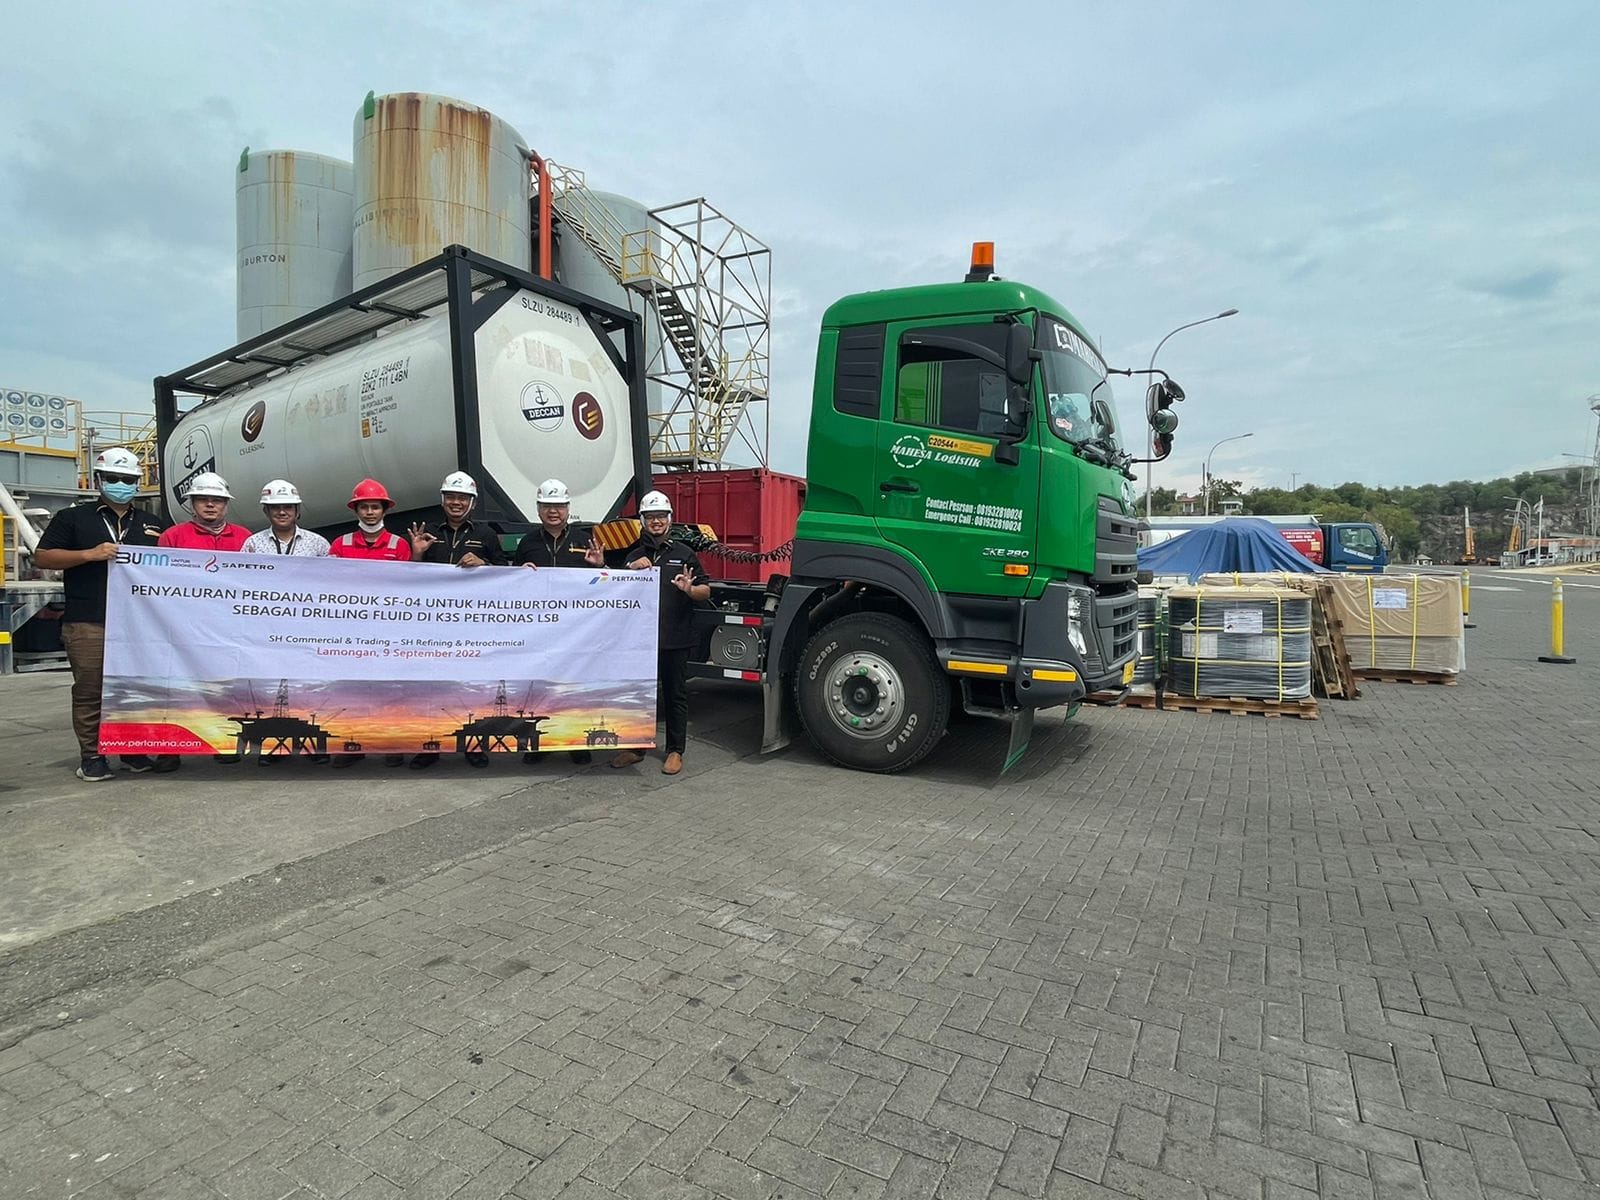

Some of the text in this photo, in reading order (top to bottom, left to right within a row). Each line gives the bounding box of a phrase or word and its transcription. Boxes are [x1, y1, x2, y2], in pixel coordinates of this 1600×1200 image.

[521, 297, 544, 314] SLZU
[546, 305, 573, 325] 284489
[363, 368, 380, 382] SLZU
[528, 406, 561, 418] DECCAN
[928, 437, 954, 448] C20544
[890, 444, 982, 468] MAHESA Logistik
[926, 497, 949, 510] Contact
[925, 509, 958, 523] Emergency
[959, 513, 972, 525] Call
[222, 562, 275, 570] SAPETRO
[131, 585, 641, 610] PENYALURAN PERDANA PRODUK SF-04 UNTUK HALLIBURTON INDONESIA
[232, 604, 560, 623] SEBAGAI DRILLING FLUID DI K3S PETRONAS LSB
[268, 634, 282, 642] SH
[286, 635, 342, 644] Commercial
[345, 637, 353, 645] &
[356, 637, 390, 647] Trading
[401, 638, 413, 646] SH
[416, 639, 453, 649] Refining
[455, 639, 463, 647] &
[465, 639, 525, 647] Petrochemical
[316, 646, 481, 659] Lamongan, 9 September 2022
[99, 739, 202, 747] www.pertamina.com
